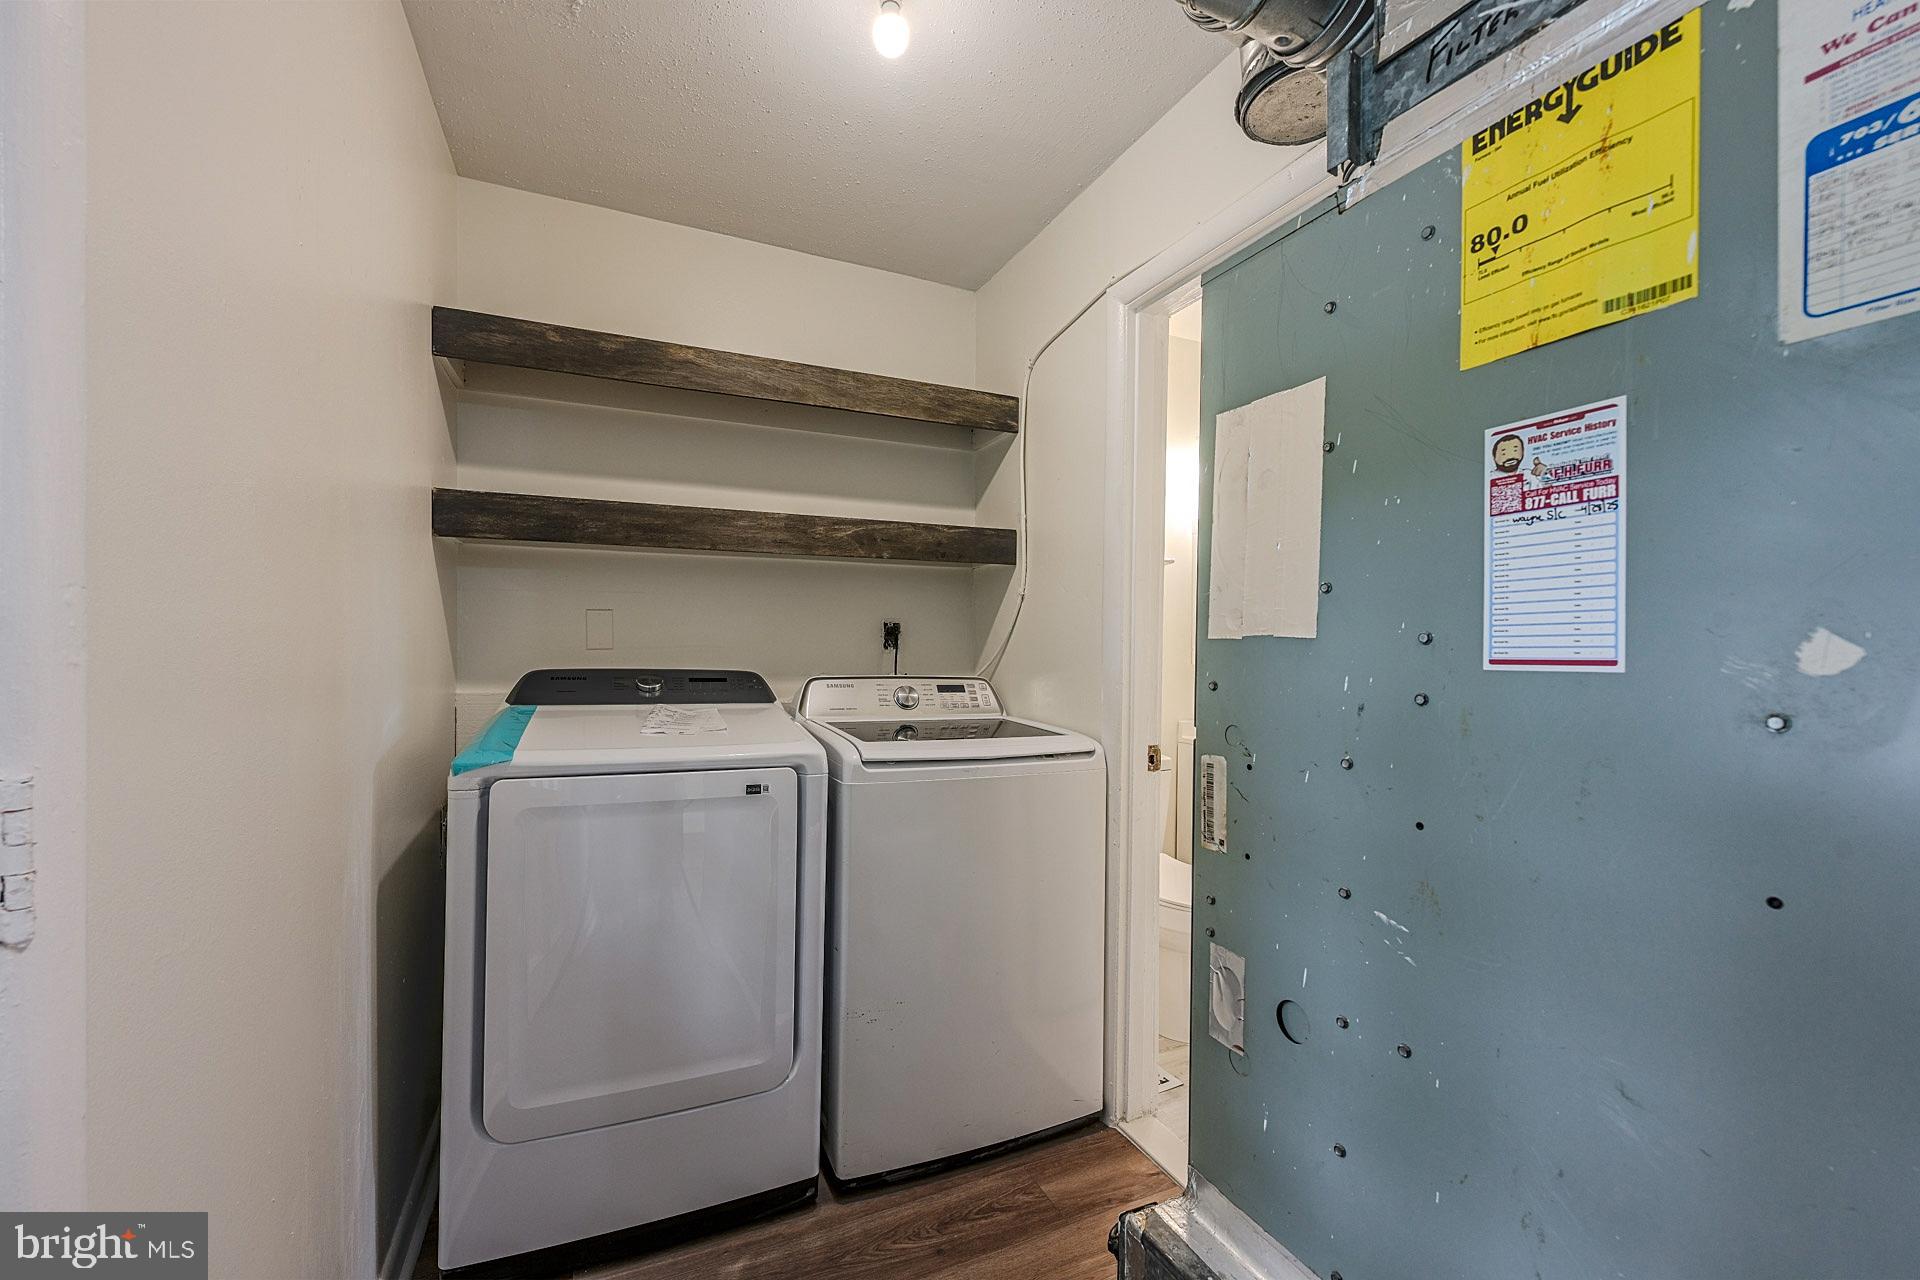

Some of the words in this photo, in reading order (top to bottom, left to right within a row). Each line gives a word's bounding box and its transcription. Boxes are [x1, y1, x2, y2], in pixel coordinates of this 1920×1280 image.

[1425, 7, 1520, 83] FILTER
[1820, 31, 1857, 54] We
[1867, 2, 1918, 33] Can
[1472, 16, 1683, 156] ENERGYGUIDE
[1506, 182, 1532, 201] Annual
[1533, 175, 1550, 189] Fuel
[1551, 156, 1588, 181] Utilization
[1470, 213, 1528, 254] 80.0
[1527, 432, 1548, 445] HVAC
[1550, 426, 1582, 440] Service
[1584, 418, 1617, 433] History
[1524, 490, 1538, 498] Call
[1538, 488, 1549, 496] For
[1524, 490, 1580, 510] 877-CALL
[1582, 484, 1617, 501] FURR
[1512, 514, 1544, 526] wayne
